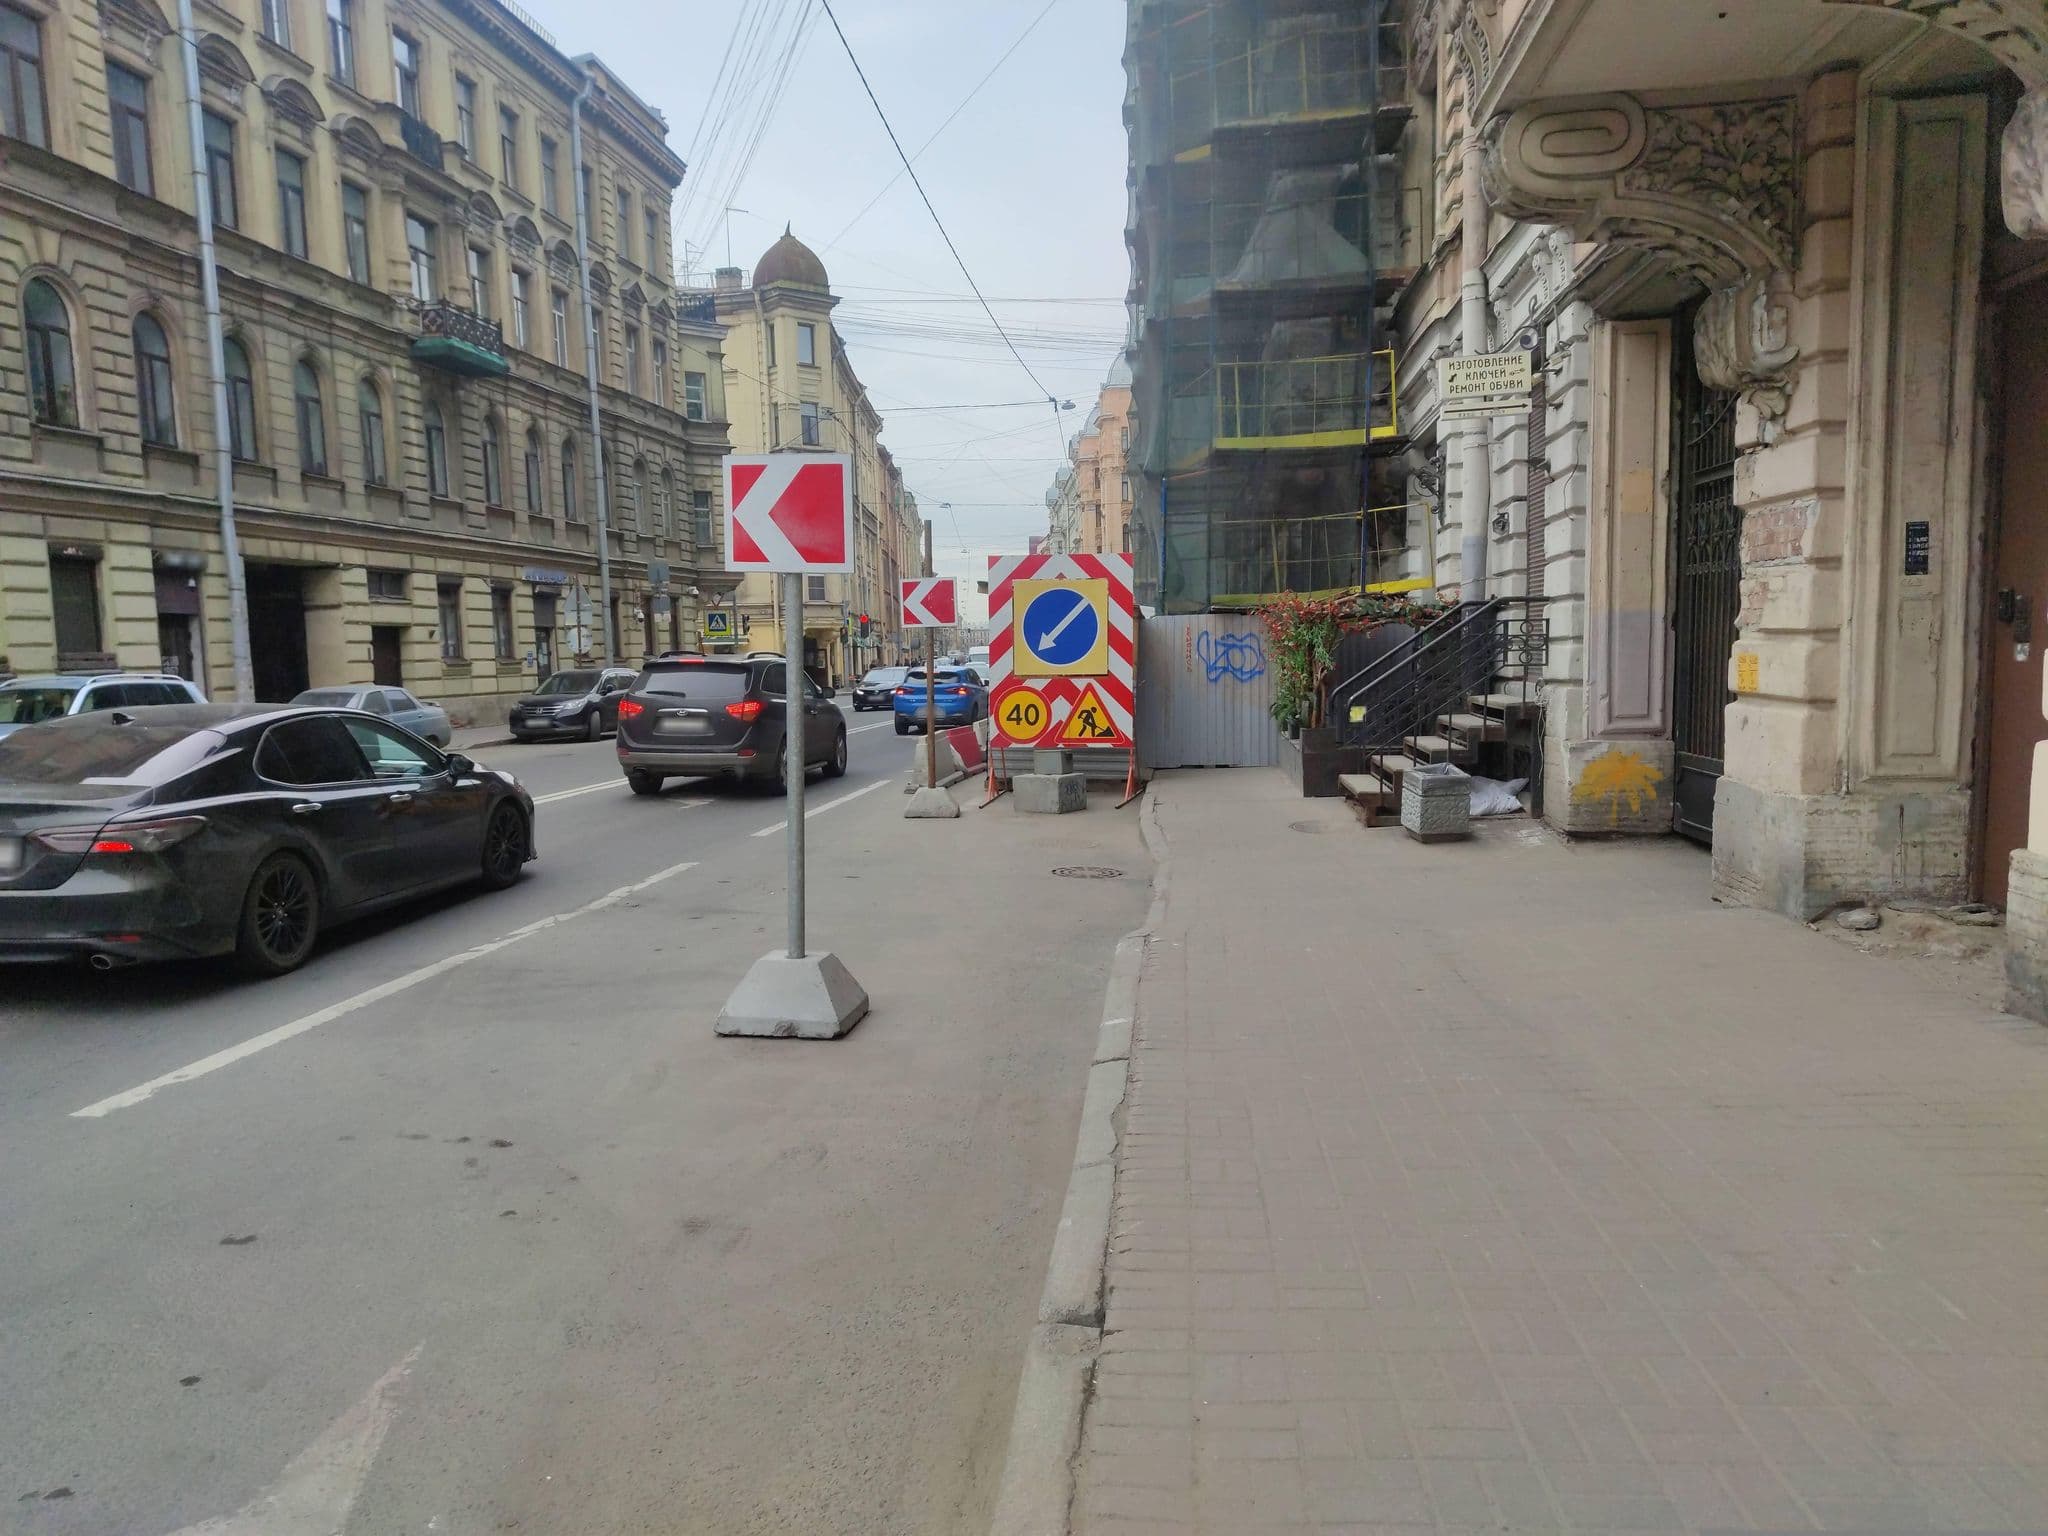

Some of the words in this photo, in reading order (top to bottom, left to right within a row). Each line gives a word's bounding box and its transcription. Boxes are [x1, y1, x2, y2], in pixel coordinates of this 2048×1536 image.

[1448, 355, 1523, 370] ИЗГОТОВЛЕНИЕ
[1465, 368, 1506, 380] КЛЮЧЕЙ
[1449, 382, 1486, 394] РЕМОНТ
[1489, 379, 1523, 391] ОБУВИ
[1006, 703, 1040, 727] 40
